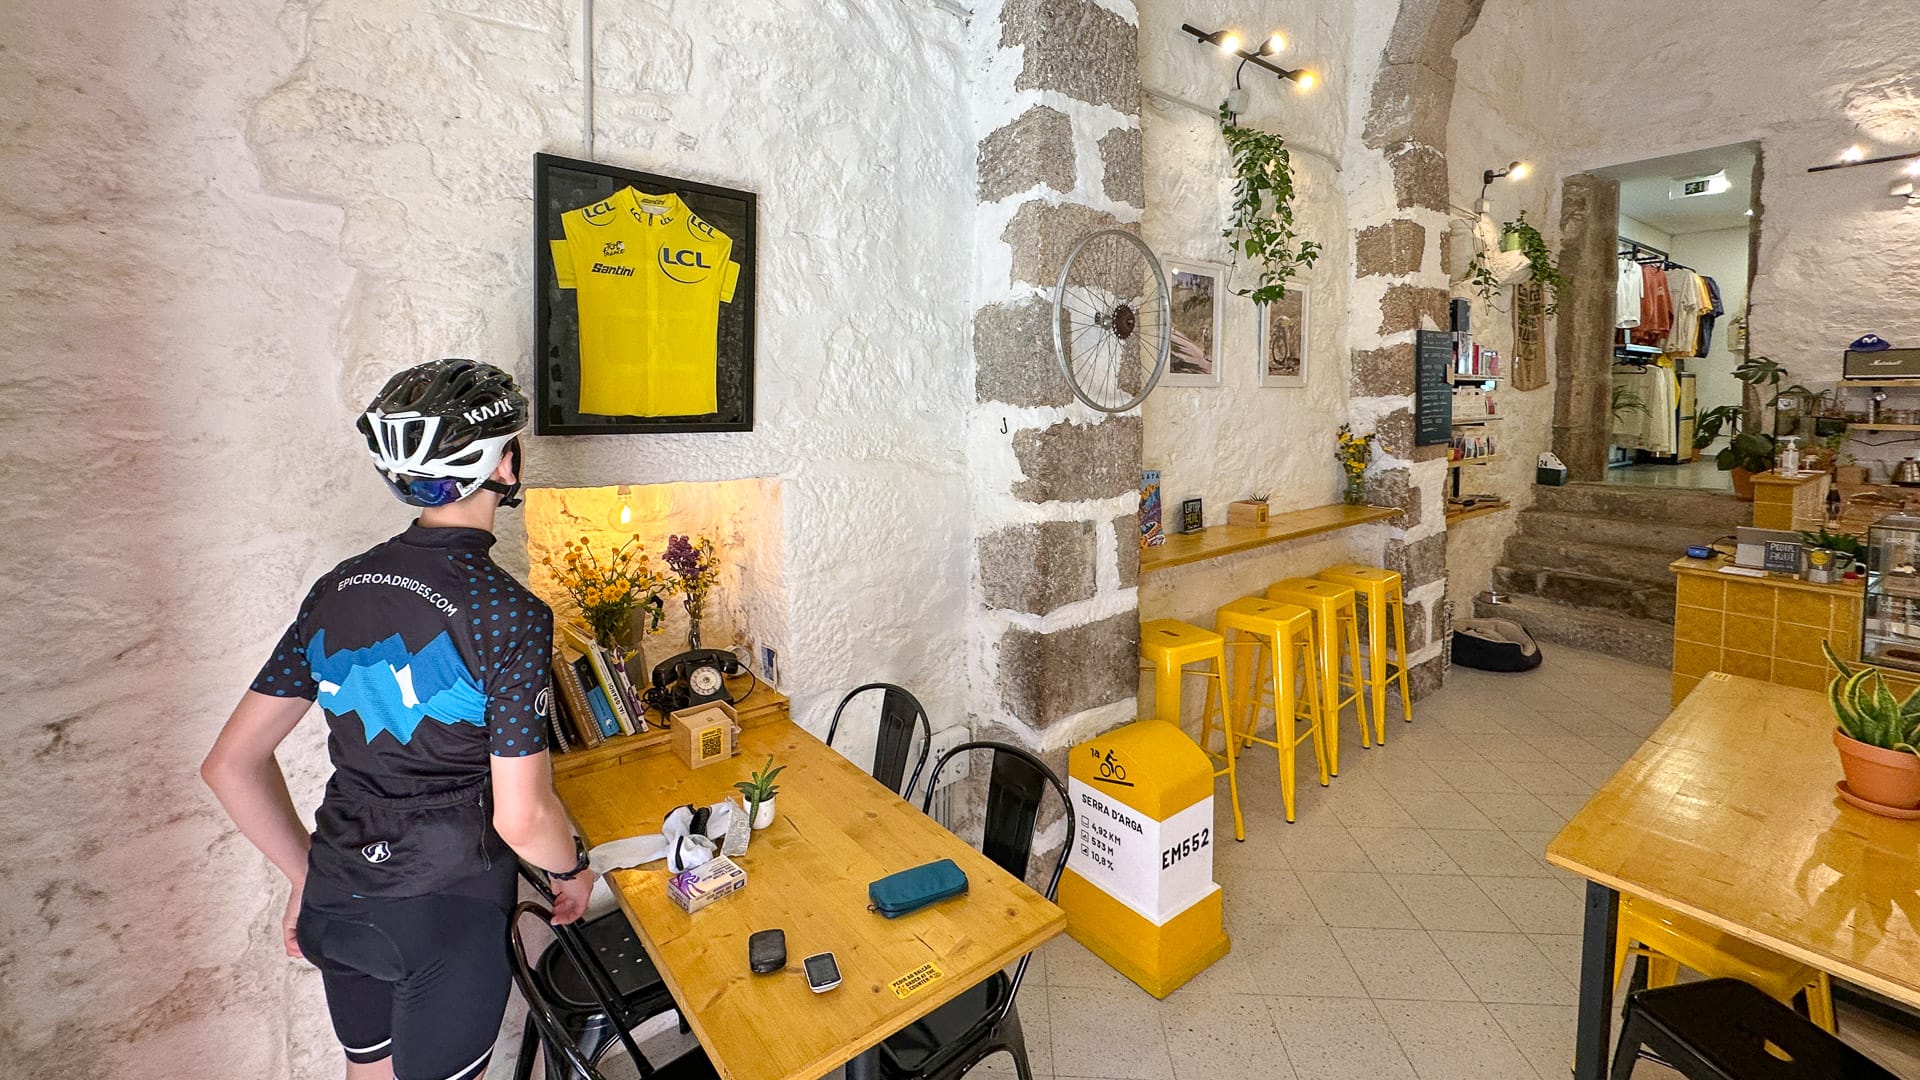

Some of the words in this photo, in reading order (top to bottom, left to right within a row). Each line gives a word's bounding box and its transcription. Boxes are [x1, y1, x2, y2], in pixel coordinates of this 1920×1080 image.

[583, 201, 616, 218] LCL
[690, 215, 716, 239] LCL
[591, 262, 636, 277] Santini
[663, 247, 712, 269] LCL
[462, 398, 514, 425] KASK
[337, 573, 458, 618] EPICROADRIDES.COM
[1081, 793, 1110, 817] SERRA
[1111, 809, 1144, 835] D'ARGA
[1091, 837, 1106, 852] 533
[1107, 847, 1114, 857] M
[1162, 827, 1210, 871] EM552
